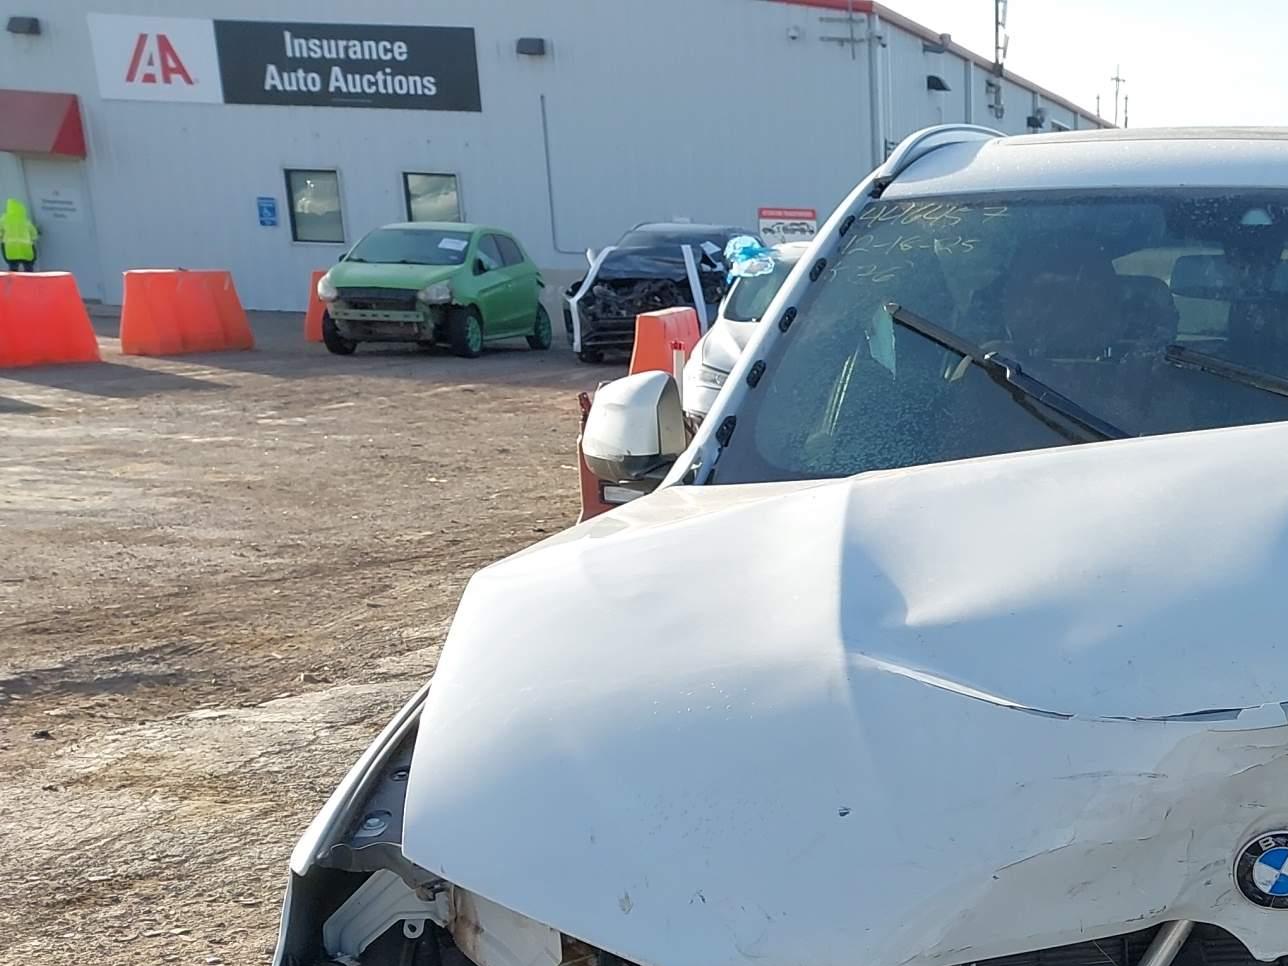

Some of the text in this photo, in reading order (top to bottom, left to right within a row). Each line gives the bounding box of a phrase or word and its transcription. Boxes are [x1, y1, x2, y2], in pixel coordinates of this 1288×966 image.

[284, 31, 408, 61] Insurance
[264, 64, 437, 96] Auto Auctions
